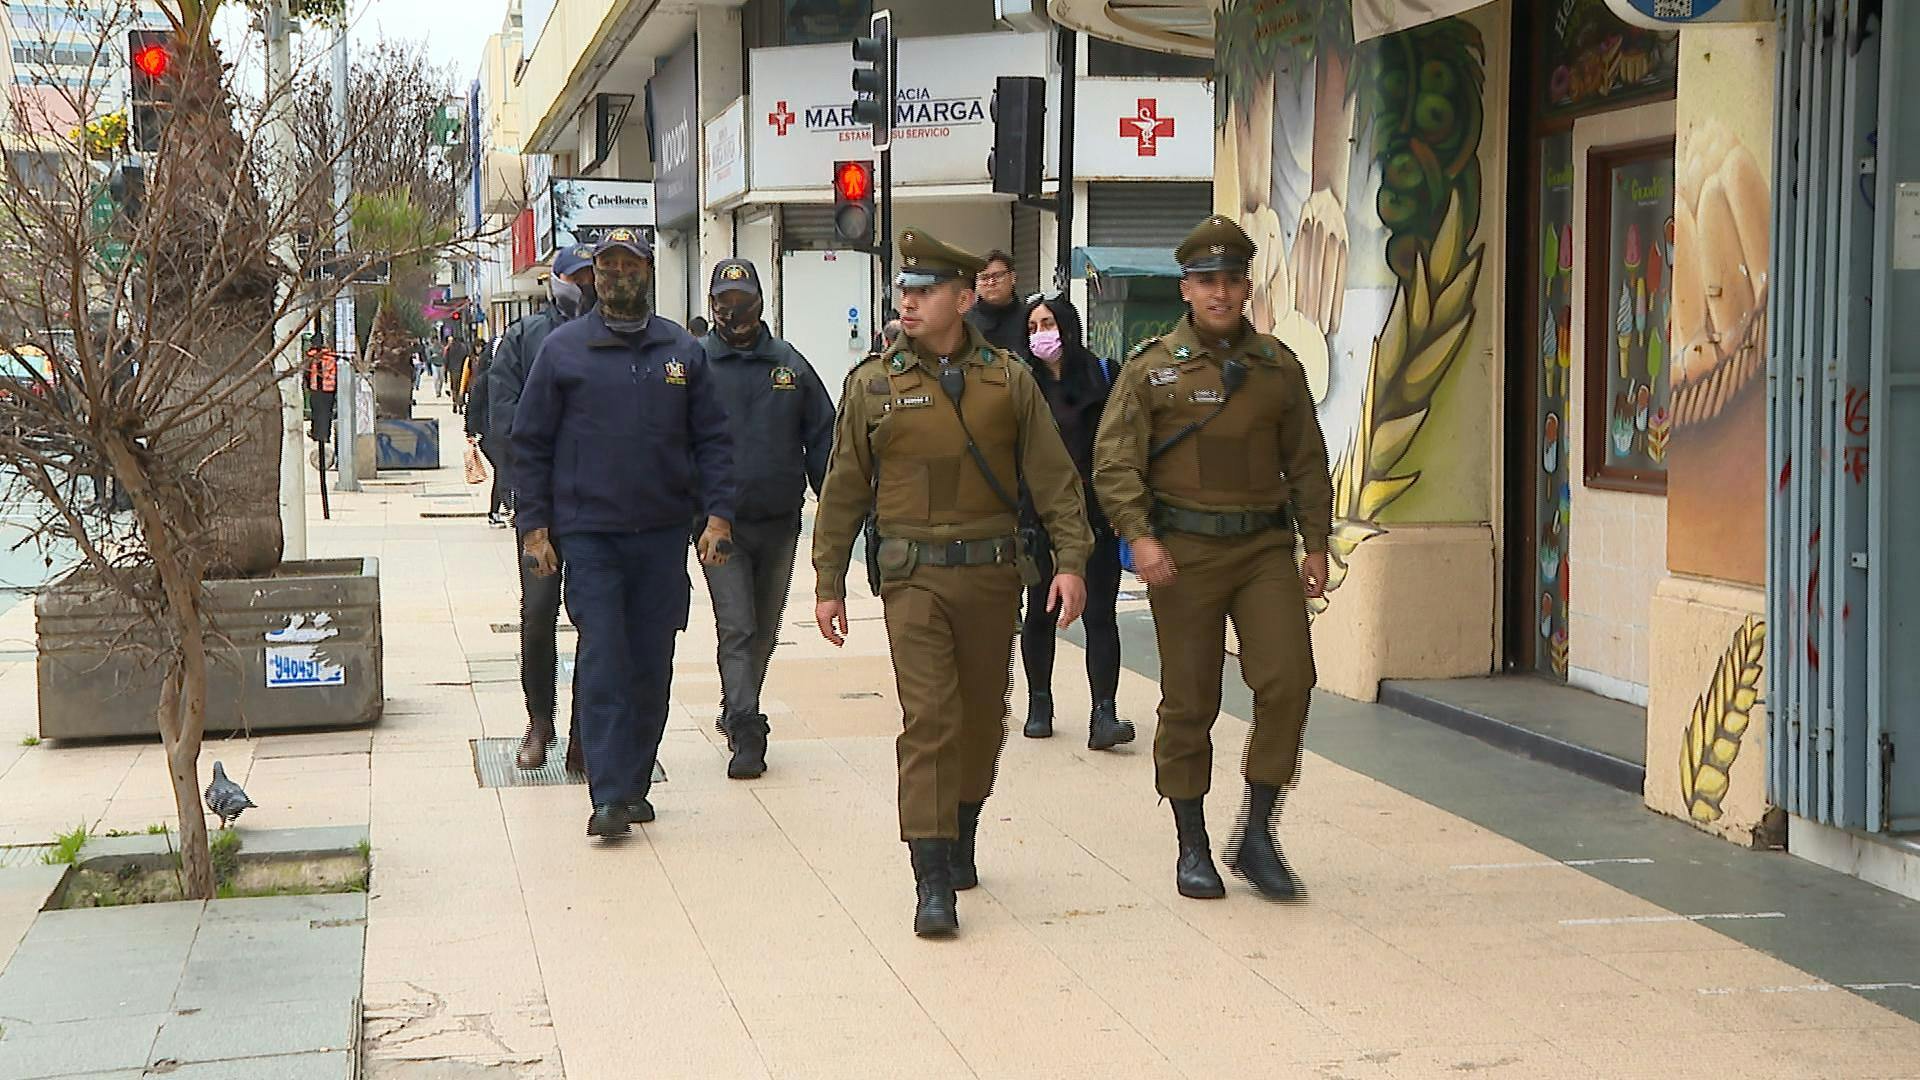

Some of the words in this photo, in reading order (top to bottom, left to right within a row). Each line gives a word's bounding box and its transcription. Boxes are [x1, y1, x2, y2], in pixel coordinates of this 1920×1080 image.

[805, 107, 855, 128] MAR
[897, 101, 984, 123] MARGA
[839, 132, 872, 142] ESTAM
[906, 127, 949, 139] SERVICIO
[588, 193, 648, 209] Cabelloteca
